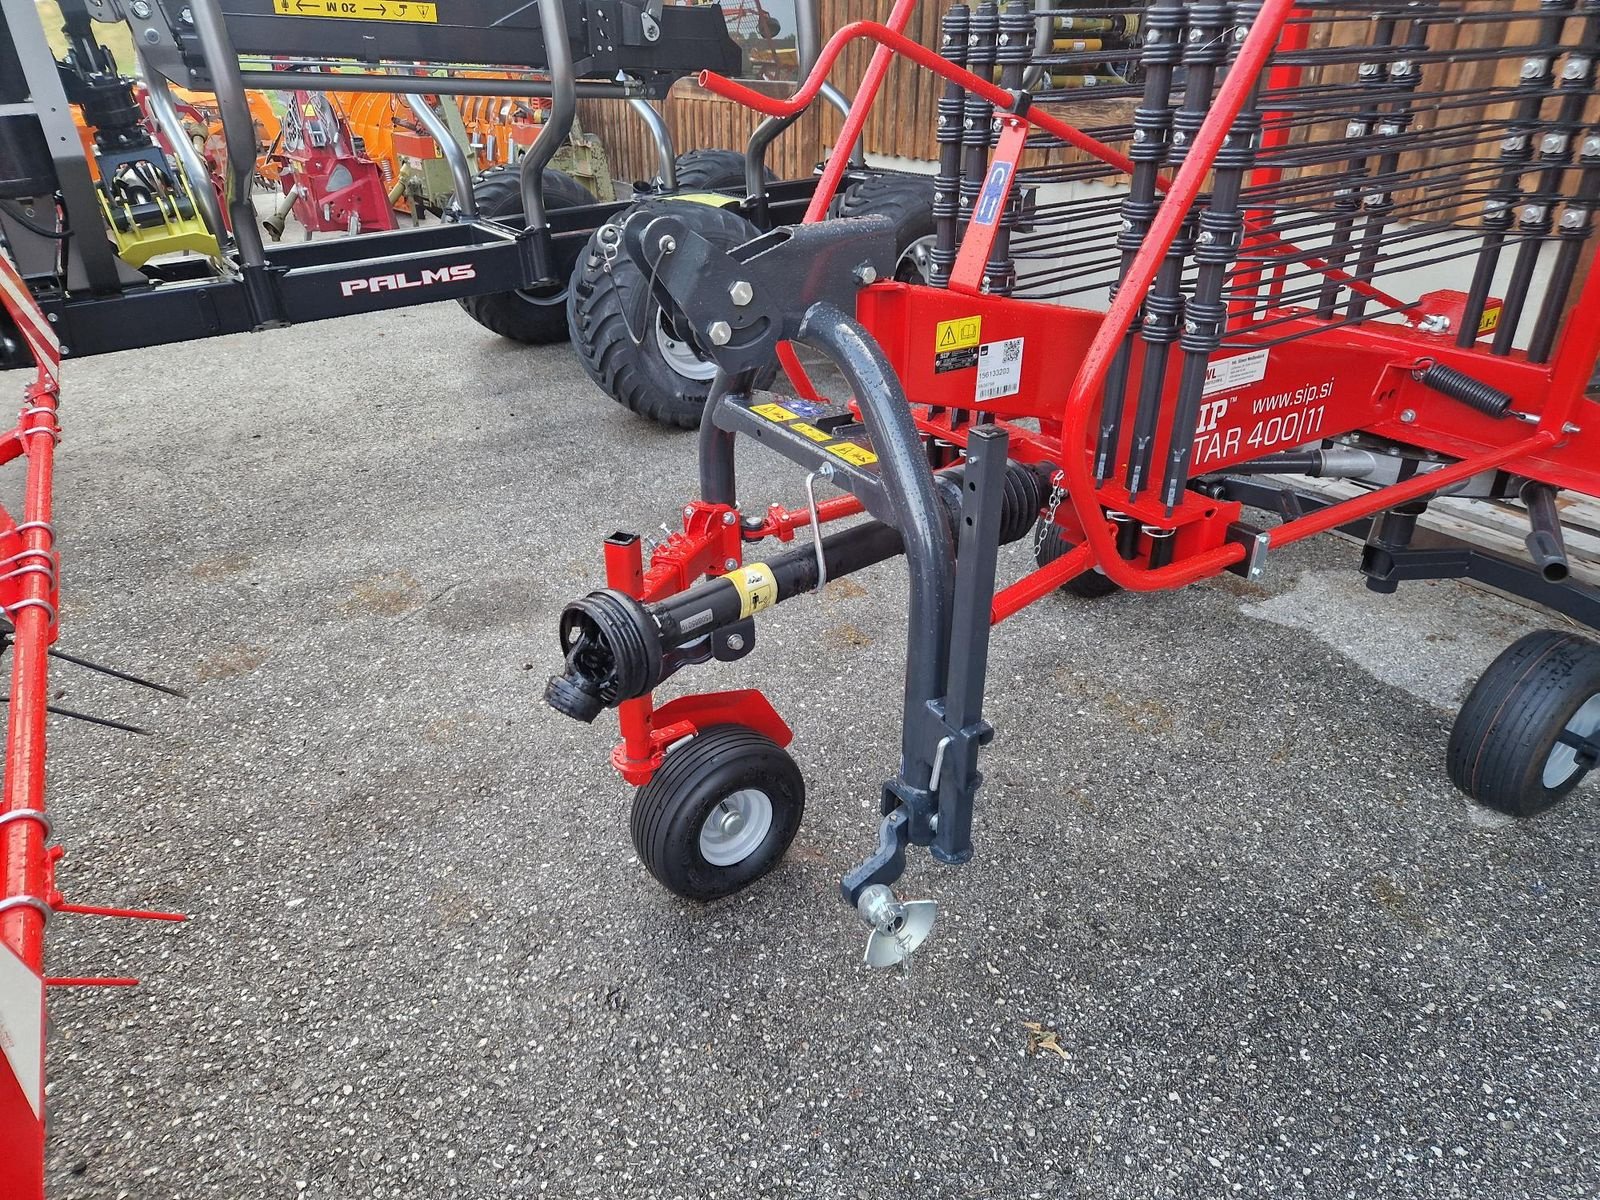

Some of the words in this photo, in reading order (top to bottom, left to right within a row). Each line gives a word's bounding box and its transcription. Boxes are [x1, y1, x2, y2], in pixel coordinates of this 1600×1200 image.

[326, 1, 337, 12] M
[341, 3, 357, 13] 20
[339, 263, 477, 297] PALMS
[1252, 377, 1335, 415] www.sip.si
[1196, 398, 1228, 434] IP
[1195, 427, 1242, 465] TAR
